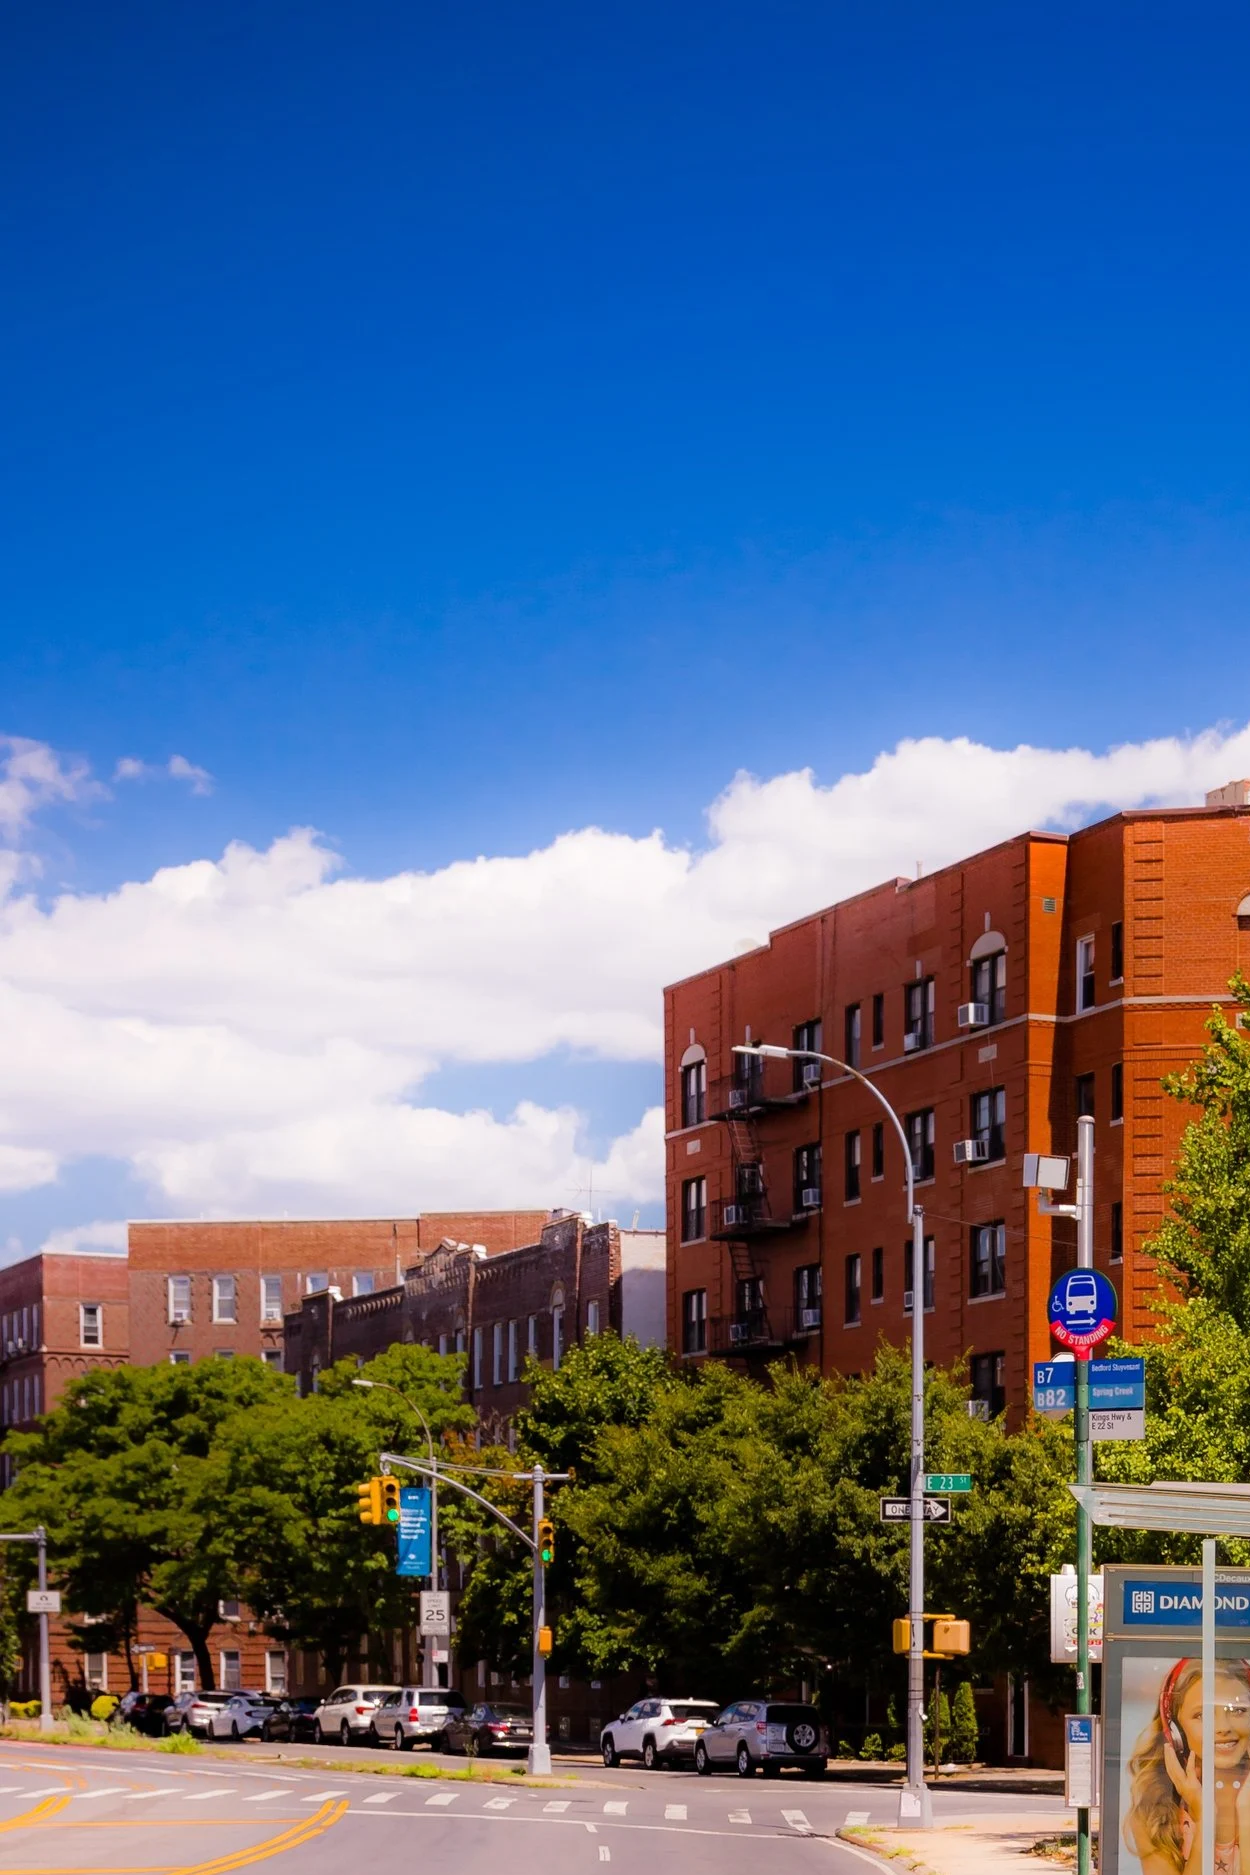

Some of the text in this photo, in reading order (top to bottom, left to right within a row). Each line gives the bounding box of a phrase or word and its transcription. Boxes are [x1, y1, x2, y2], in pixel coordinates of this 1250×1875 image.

[1055, 1325, 1109, 1345] NO STANDING
[1037, 1367, 1054, 1384] B7
[1037, 1388, 1066, 1407] B82
[1091, 1414, 1110, 1422] Kings
[1111, 1413, 1126, 1422] Hwy
[1097, 1422, 1106, 1430] 22
[1106, 1421, 1115, 1430] St
[927, 1476, 933, 1489] E
[940, 1476, 954, 1489] 23
[891, 1505, 911, 1515] ONE
[425, 1609, 446, 1622] 25
